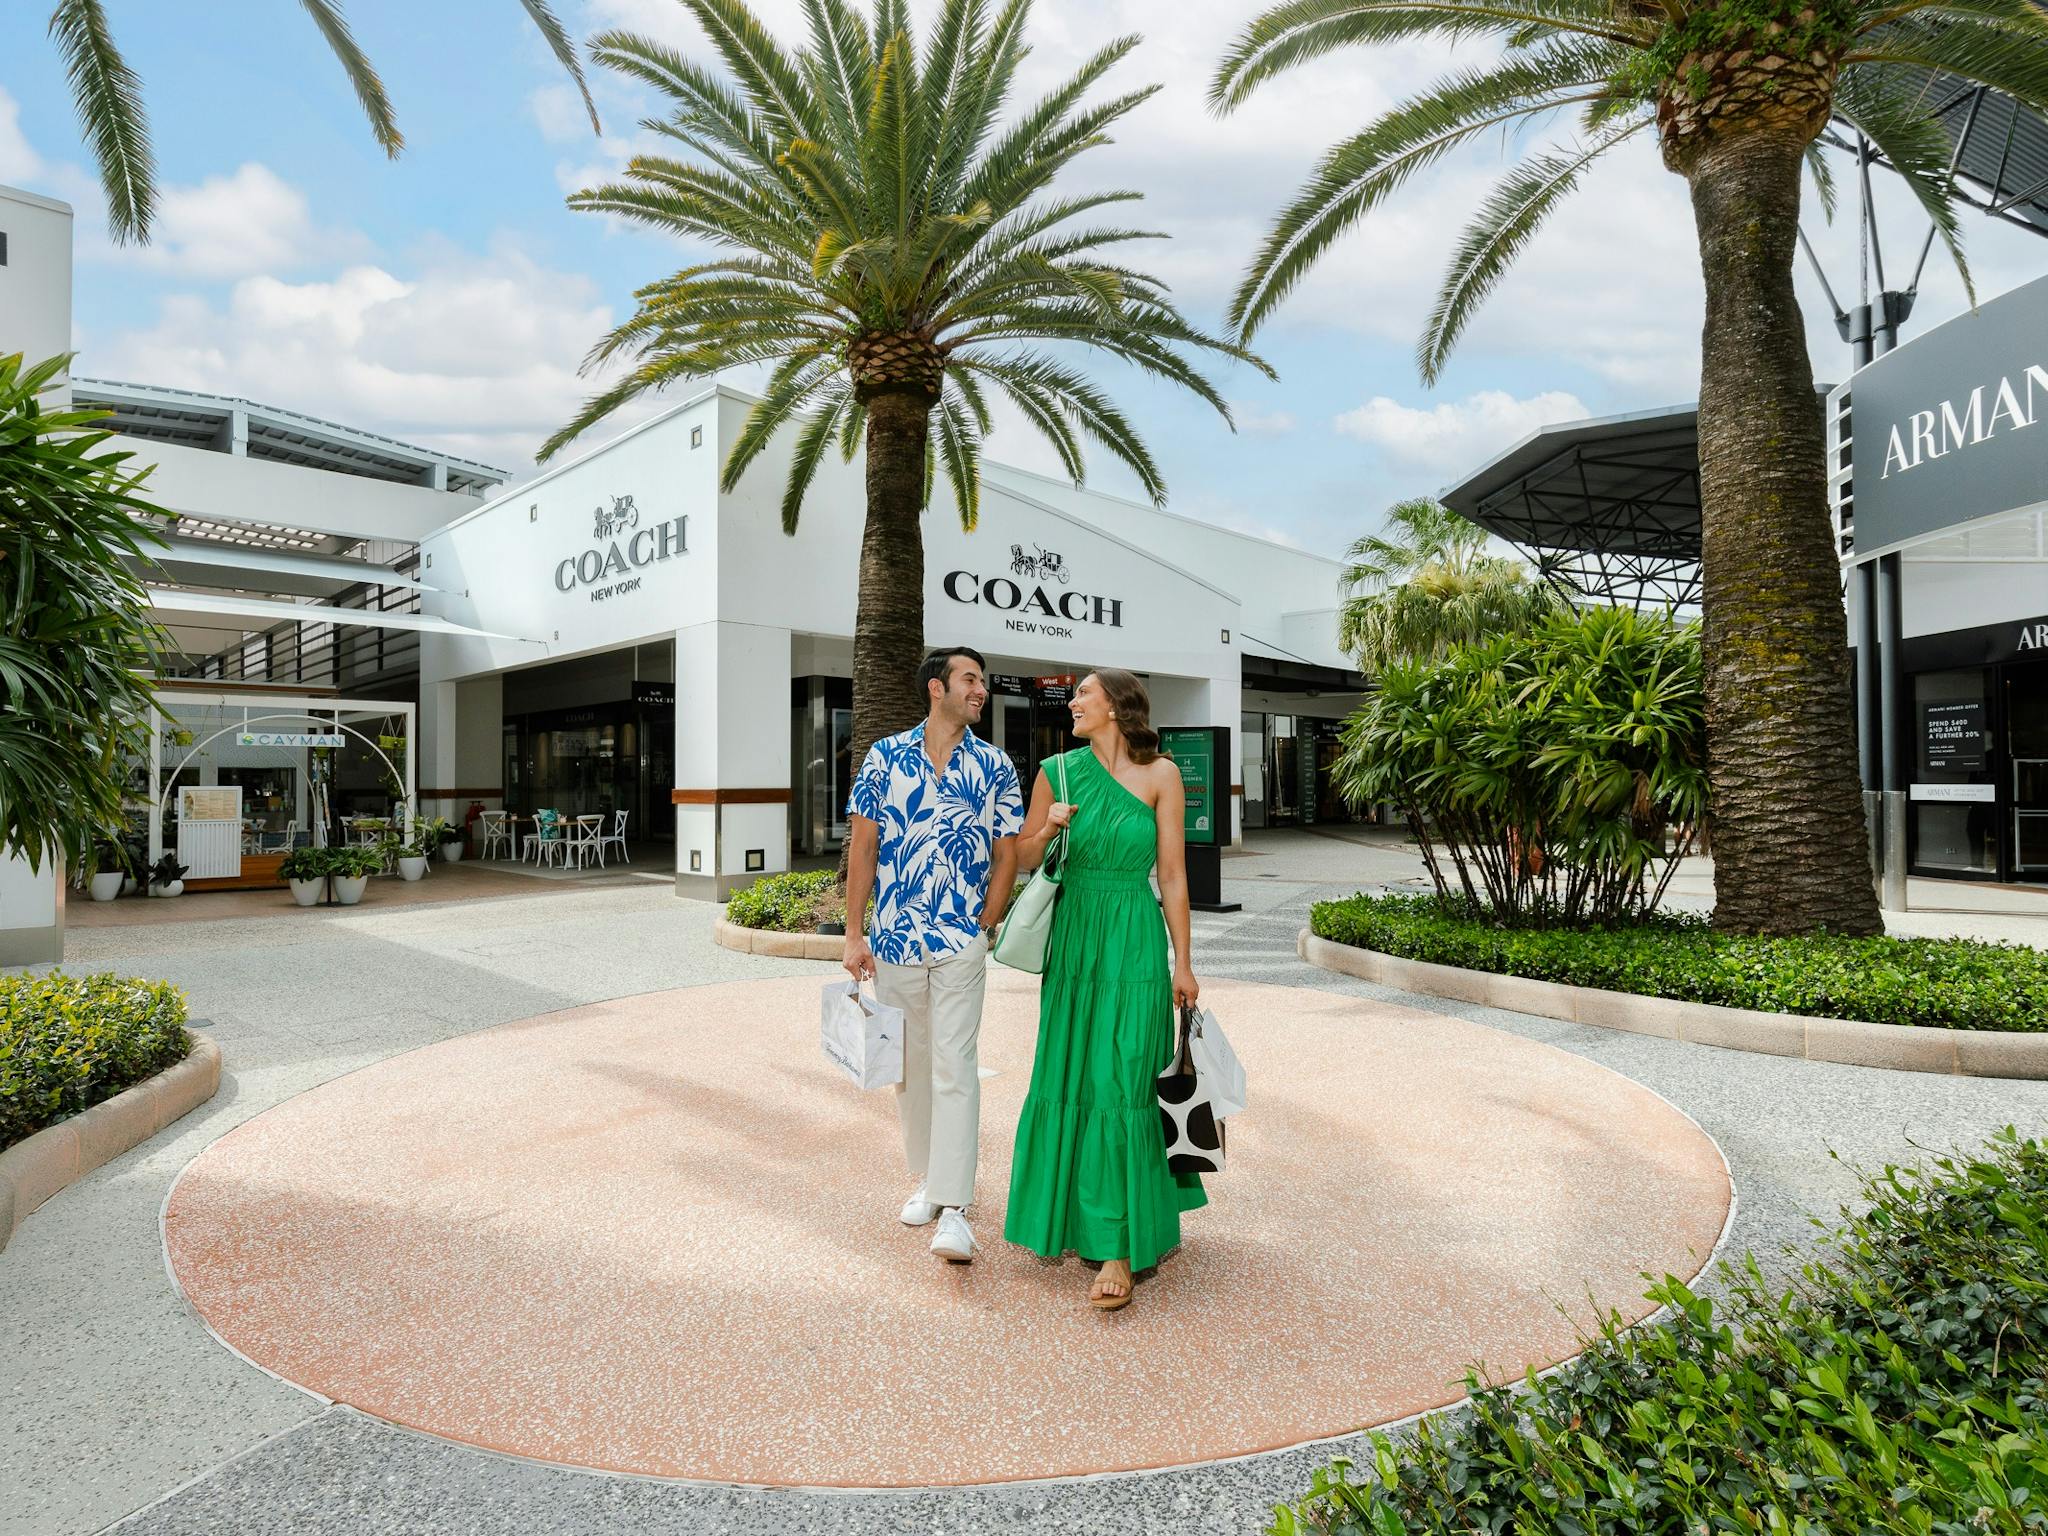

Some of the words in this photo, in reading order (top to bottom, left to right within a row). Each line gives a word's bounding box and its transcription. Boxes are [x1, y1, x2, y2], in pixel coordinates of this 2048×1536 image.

[555, 514, 689, 592] COACH
[591, 586, 613, 602] NEW
[614, 577, 641, 595] YORK
[943, 570, 1124, 627] COACH
[1006, 619, 1037, 633] NEW
[1039, 624, 1072, 639] YORK
[258, 735, 342, 746] CAYMAN
